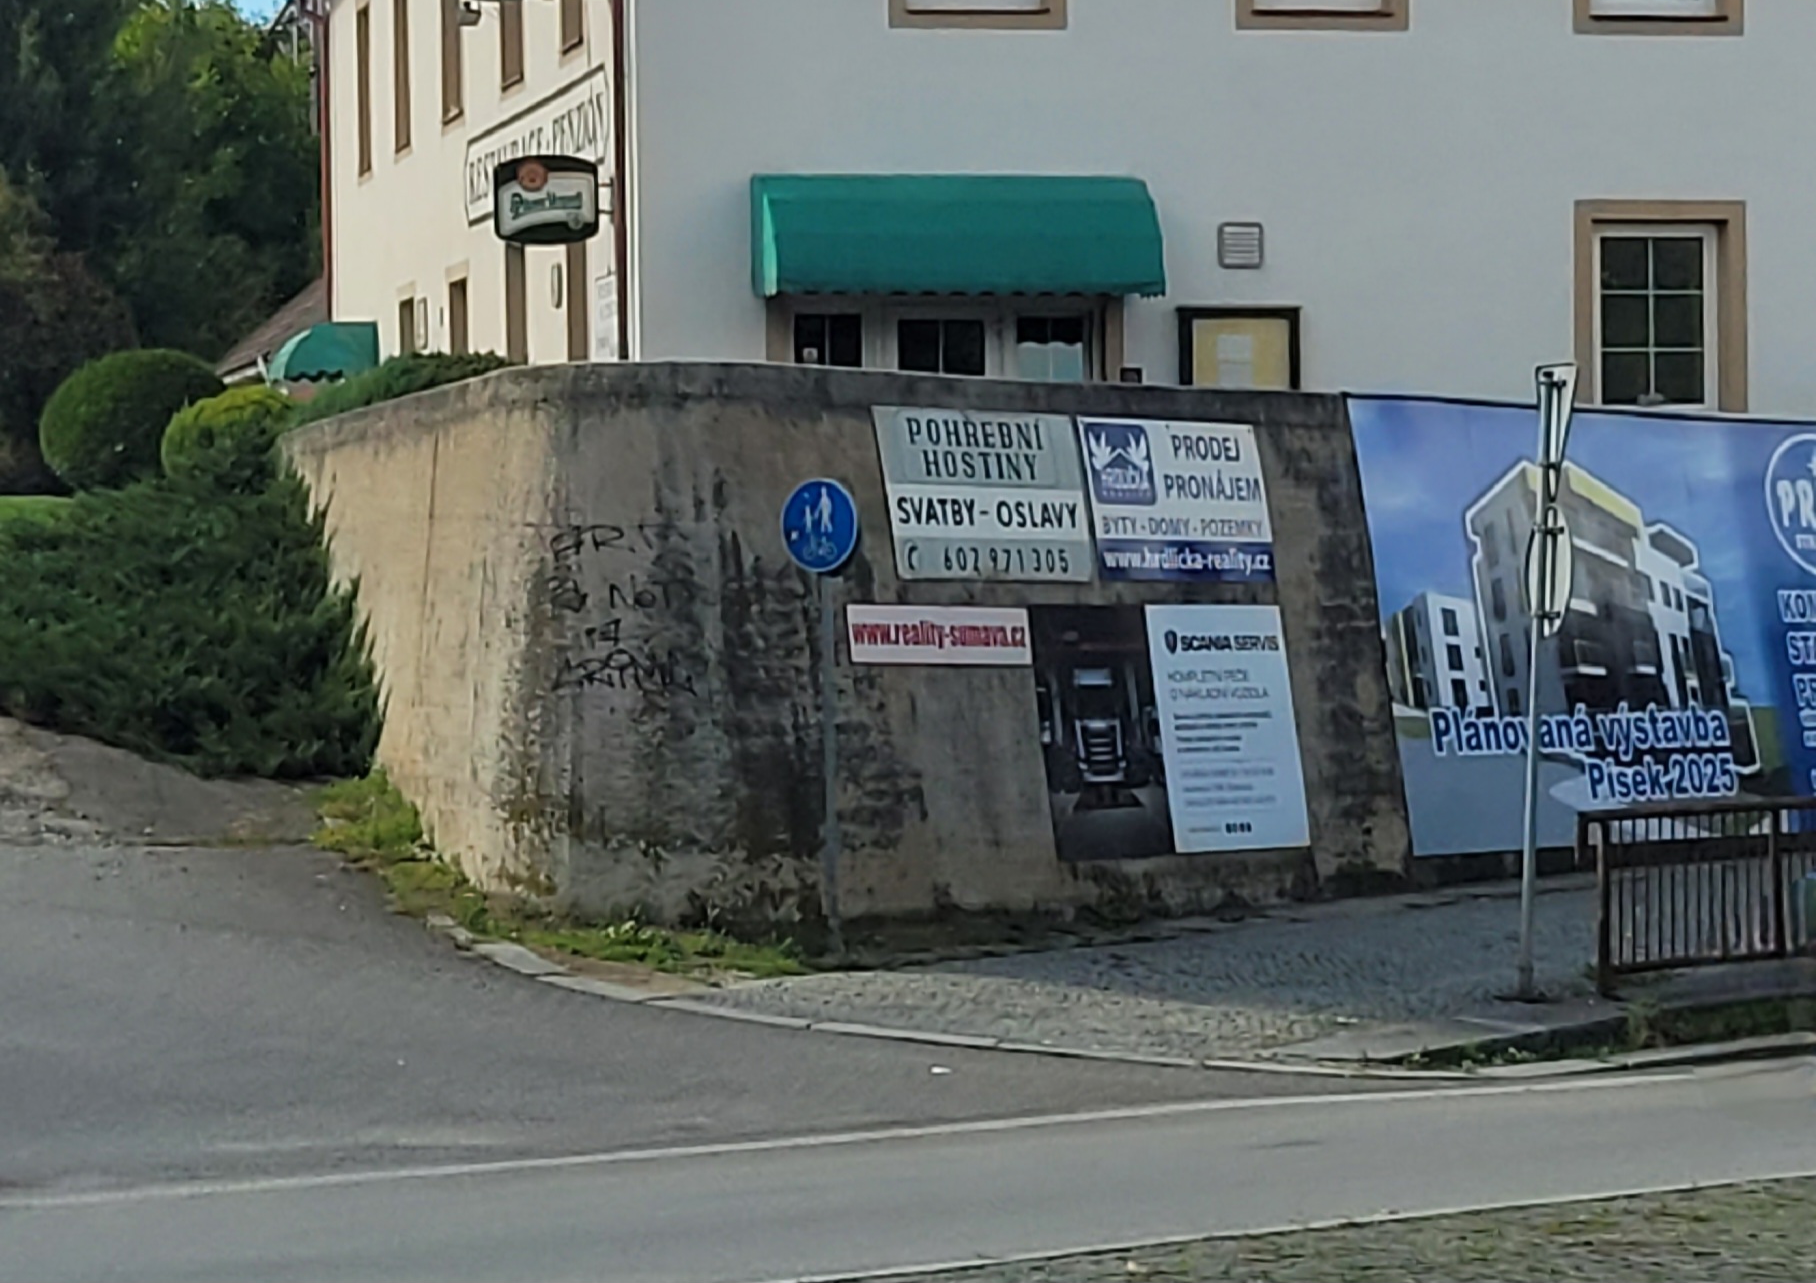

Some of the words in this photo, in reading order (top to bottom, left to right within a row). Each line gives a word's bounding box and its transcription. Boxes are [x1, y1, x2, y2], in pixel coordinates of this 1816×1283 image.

[1171, 434, 1241, 462] PRODEJ
[922, 450, 1037, 480] HOSTINY
[1163, 469, 1262, 502] PRONÁJEM
[897, 496, 975, 526] SVATBY
[996, 500, 1078, 529] OSLAVY
[1103, 516, 1137, 535] BYTY
[1148, 518, 1190, 536] DOMY
[943, 545, 979, 572] 602
[989, 546, 1024, 573] 971
[1180, 635, 1232, 651] SCANIA
[1233, 635, 1279, 651] SERVIS
[1787, 632, 1816, 663] ST
[1430, 705, 1592, 754] Plánovaná
[1597, 702, 1729, 760] výstavba
[1670, 754, 1736, 797] 2025
